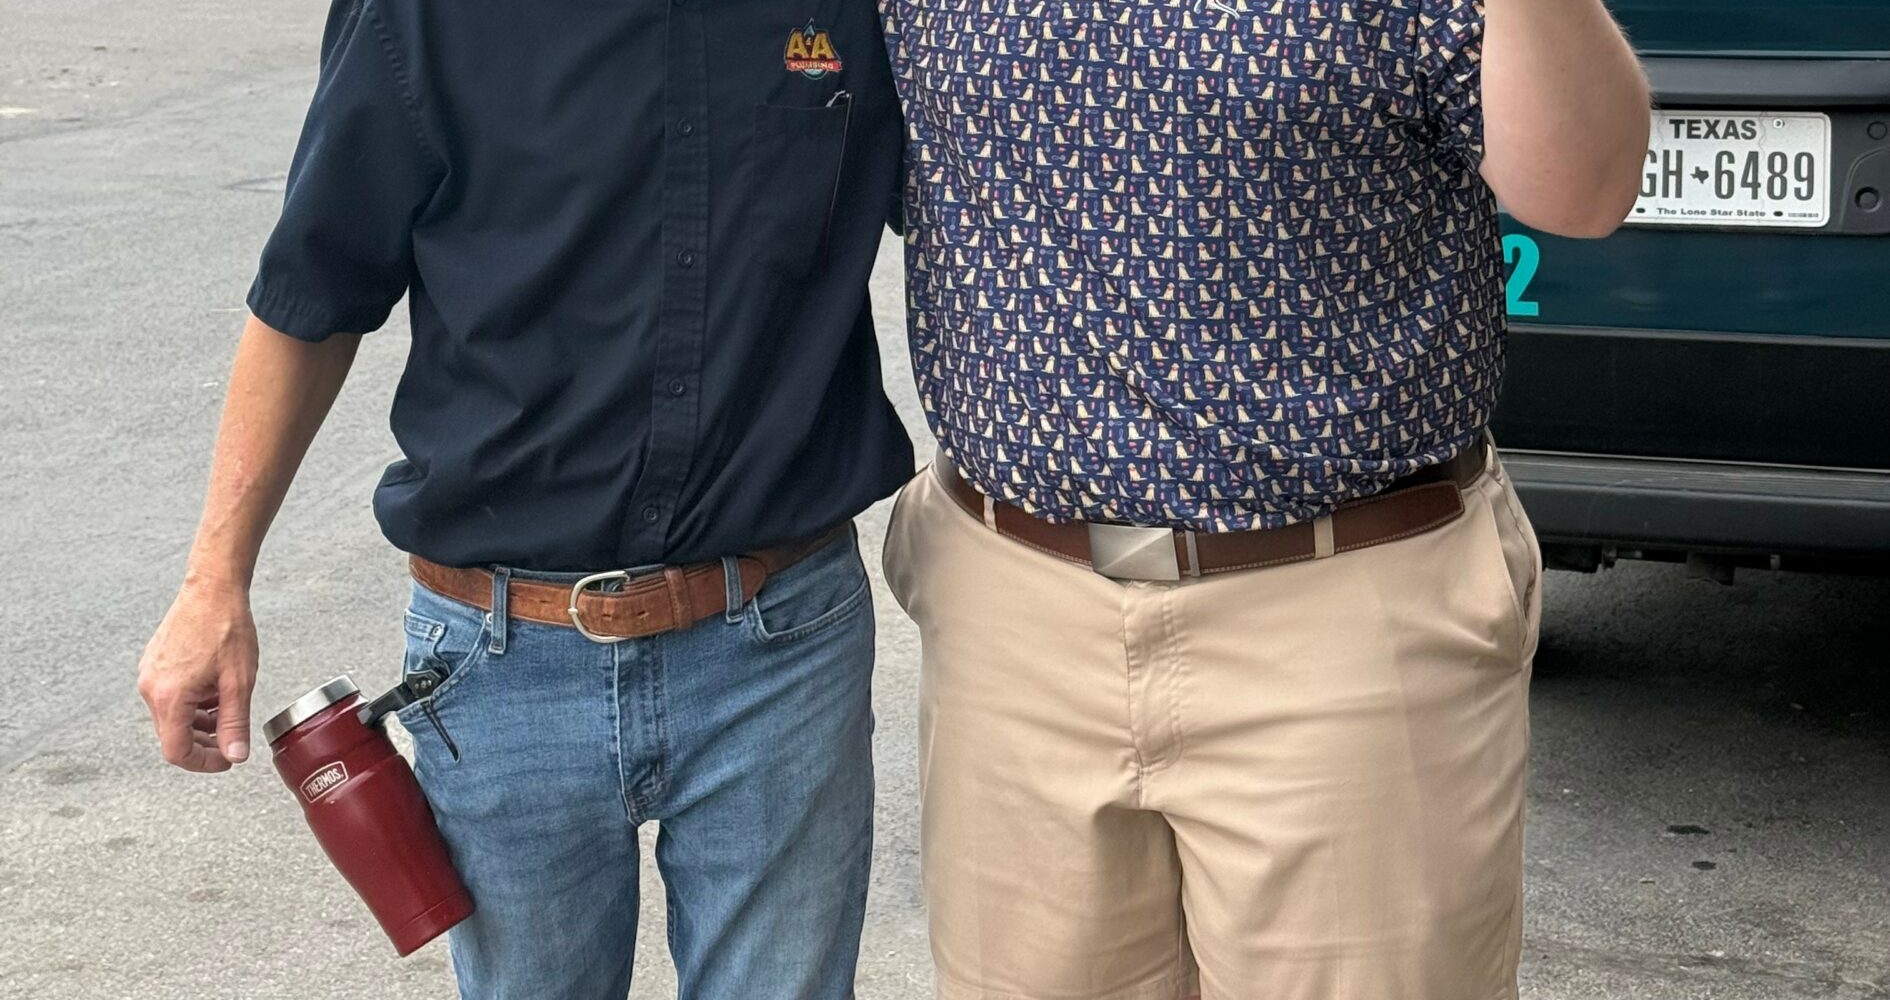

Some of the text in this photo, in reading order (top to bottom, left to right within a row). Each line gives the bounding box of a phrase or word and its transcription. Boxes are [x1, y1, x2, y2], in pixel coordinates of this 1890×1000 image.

[1668, 118, 1758, 141] TEXAS
[1713, 150, 1815, 201] 6489
[1657, 207, 1766, 218] The Lone Star State
[1501, 233, 1540, 316] 2
[305, 768, 341, 798] THERMOS
